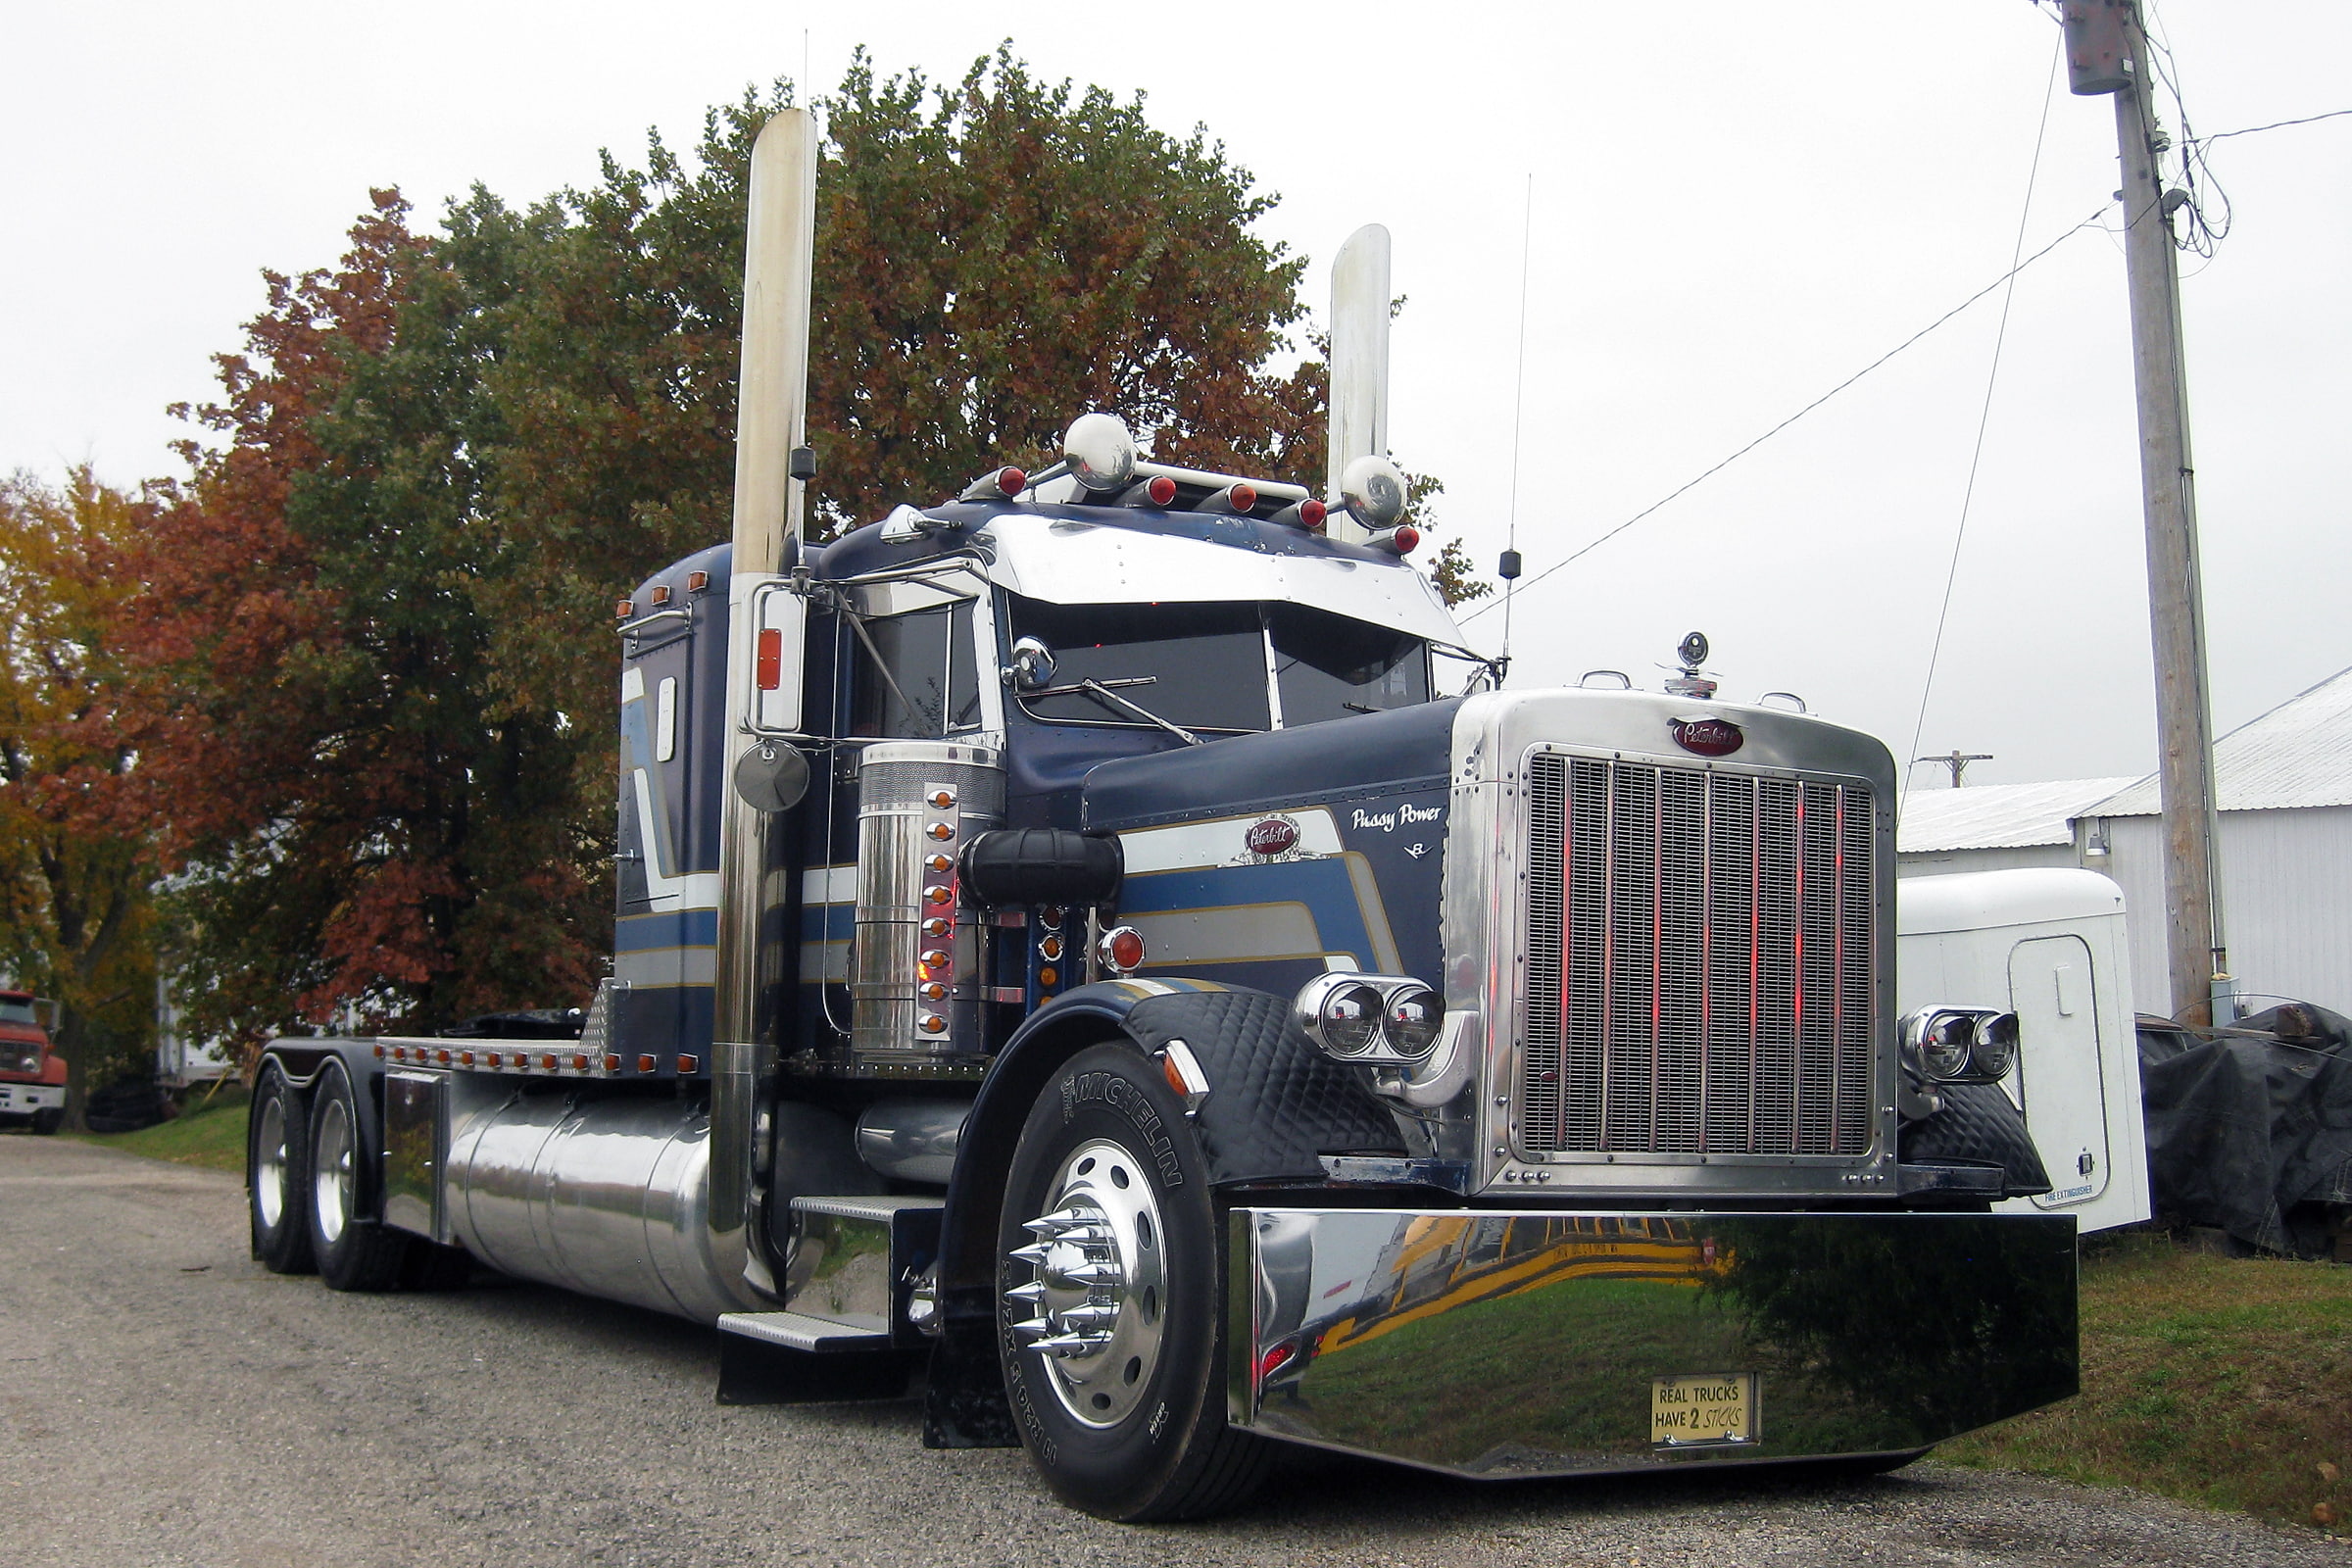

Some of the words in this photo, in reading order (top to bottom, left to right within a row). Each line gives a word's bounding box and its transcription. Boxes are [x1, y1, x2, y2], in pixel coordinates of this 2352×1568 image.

[1350, 808, 1396, 833] Pussy
[1397, 803, 1444, 826] Power
[1250, 825, 1292, 847] Peterbilt
[1074, 1072, 1184, 1188] MICHELIN
[2044, 1192, 2056, 1202] FIRE
[2057, 1184, 2093, 1200] EXTINGUISHER
[1659, 1388, 1688, 1403] REAL
[1693, 1386, 1740, 1402] TRUCKS
[1655, 1411, 1687, 1428] HAVE
[1690, 1407, 1699, 1429] 2
[1702, 1406, 1742, 1429] STICKS
